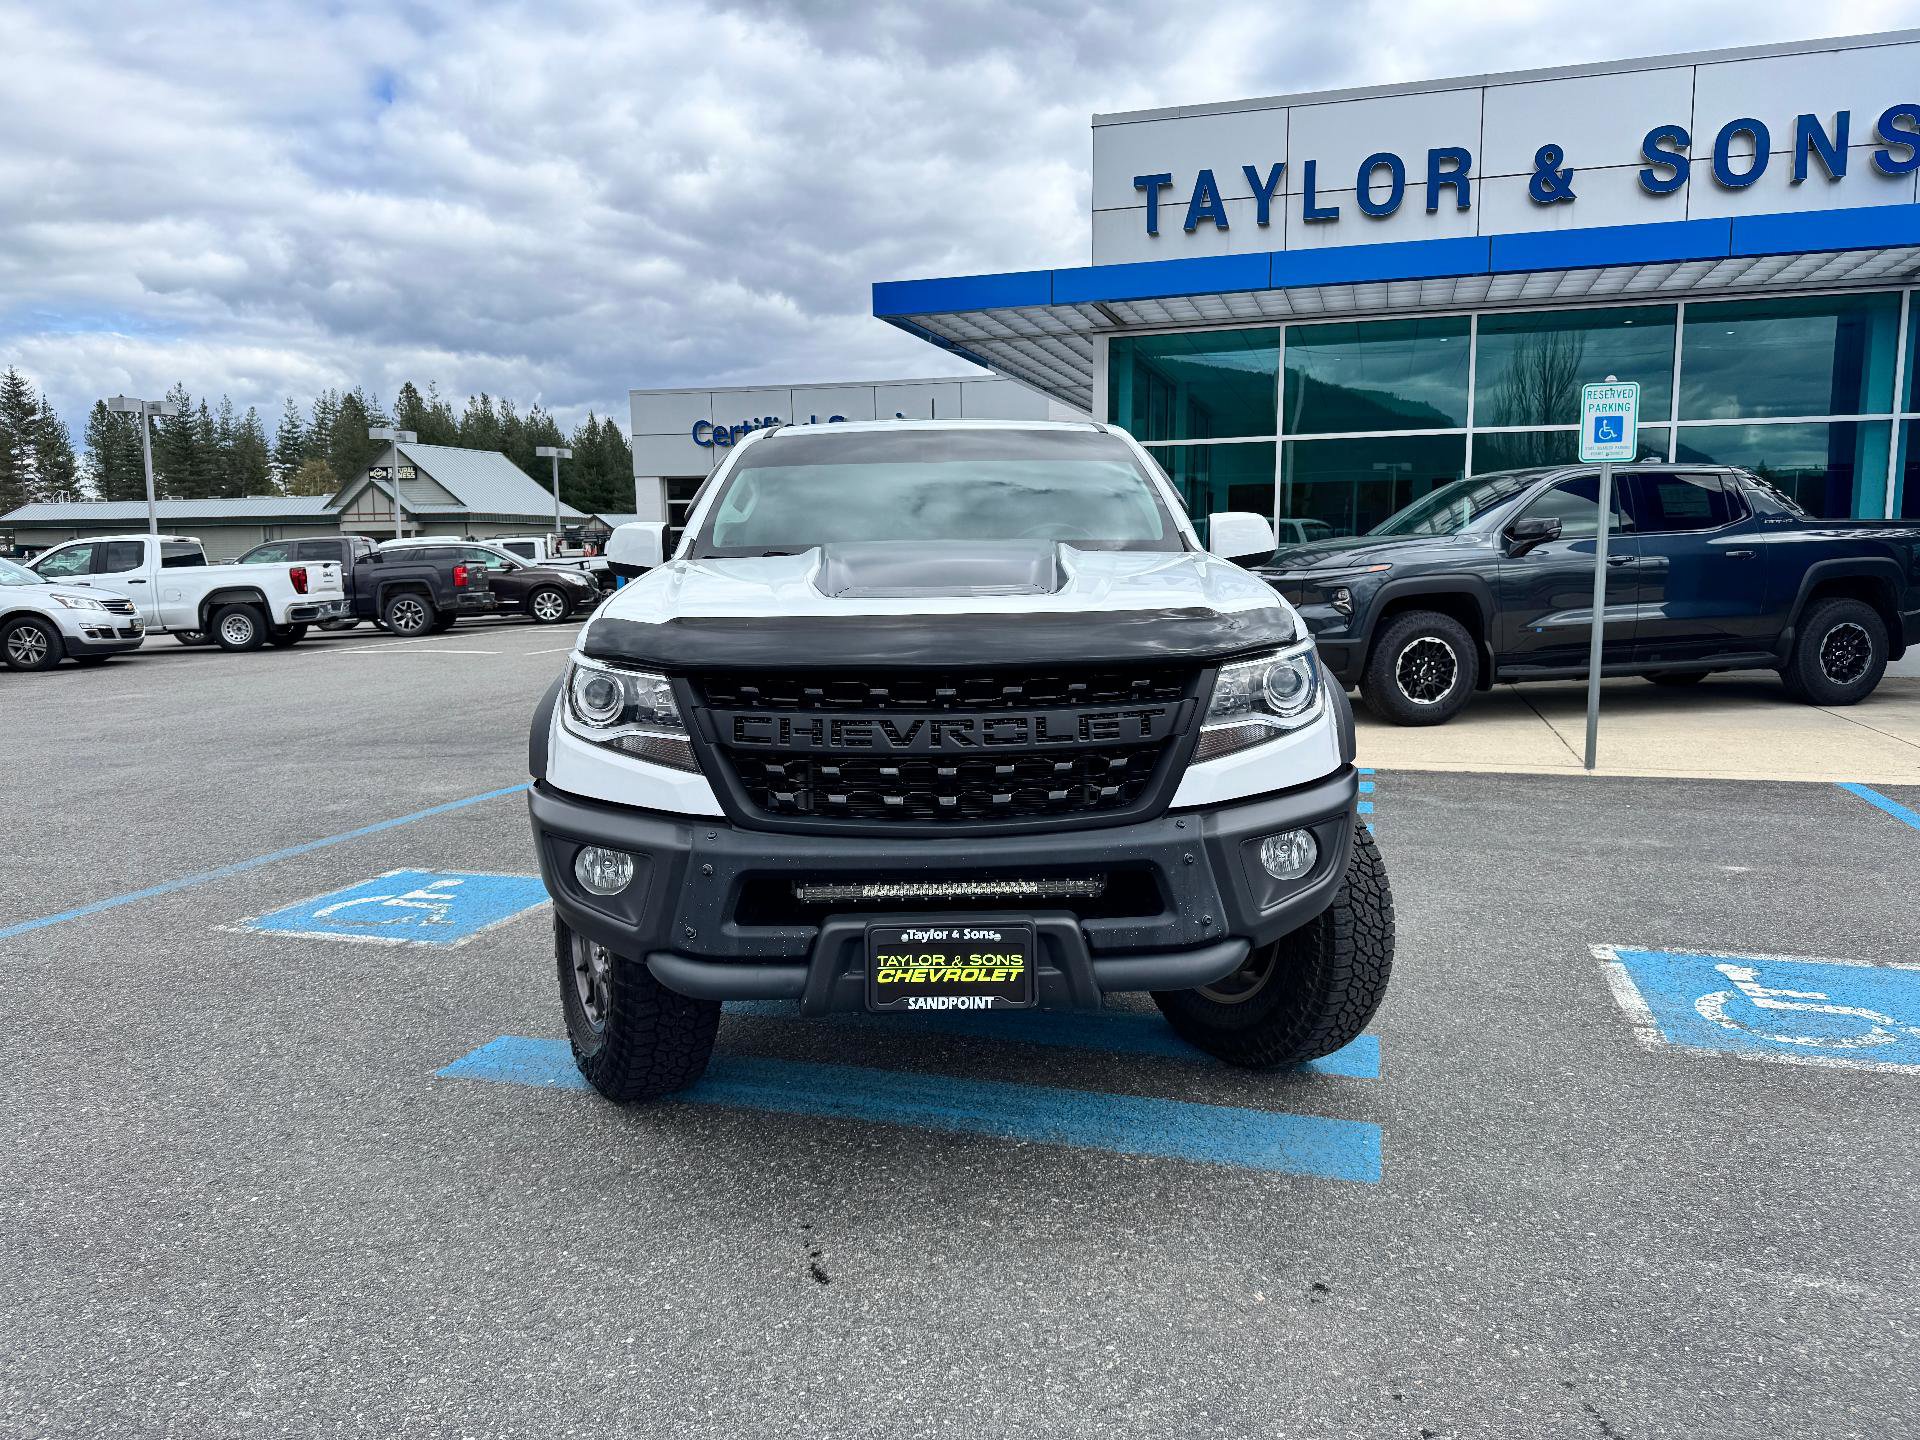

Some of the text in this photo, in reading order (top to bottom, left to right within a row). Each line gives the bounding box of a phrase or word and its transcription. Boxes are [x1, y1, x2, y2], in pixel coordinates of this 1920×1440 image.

[1133, 104, 1920, 237] TAYLOR & SONS
[1587, 389, 1633, 399] RESERVED
[1589, 402, 1631, 412] PARKING
[692, 415, 816, 447] Certi
[733, 708, 1166, 748] CHEVROLET
[907, 929, 994, 943] Taylor & Sons
[877, 954, 1024, 969] TAYLOR & SONS
[877, 969, 1024, 983] CHEVROLET
[907, 996, 995, 1010] SANDPOINT
